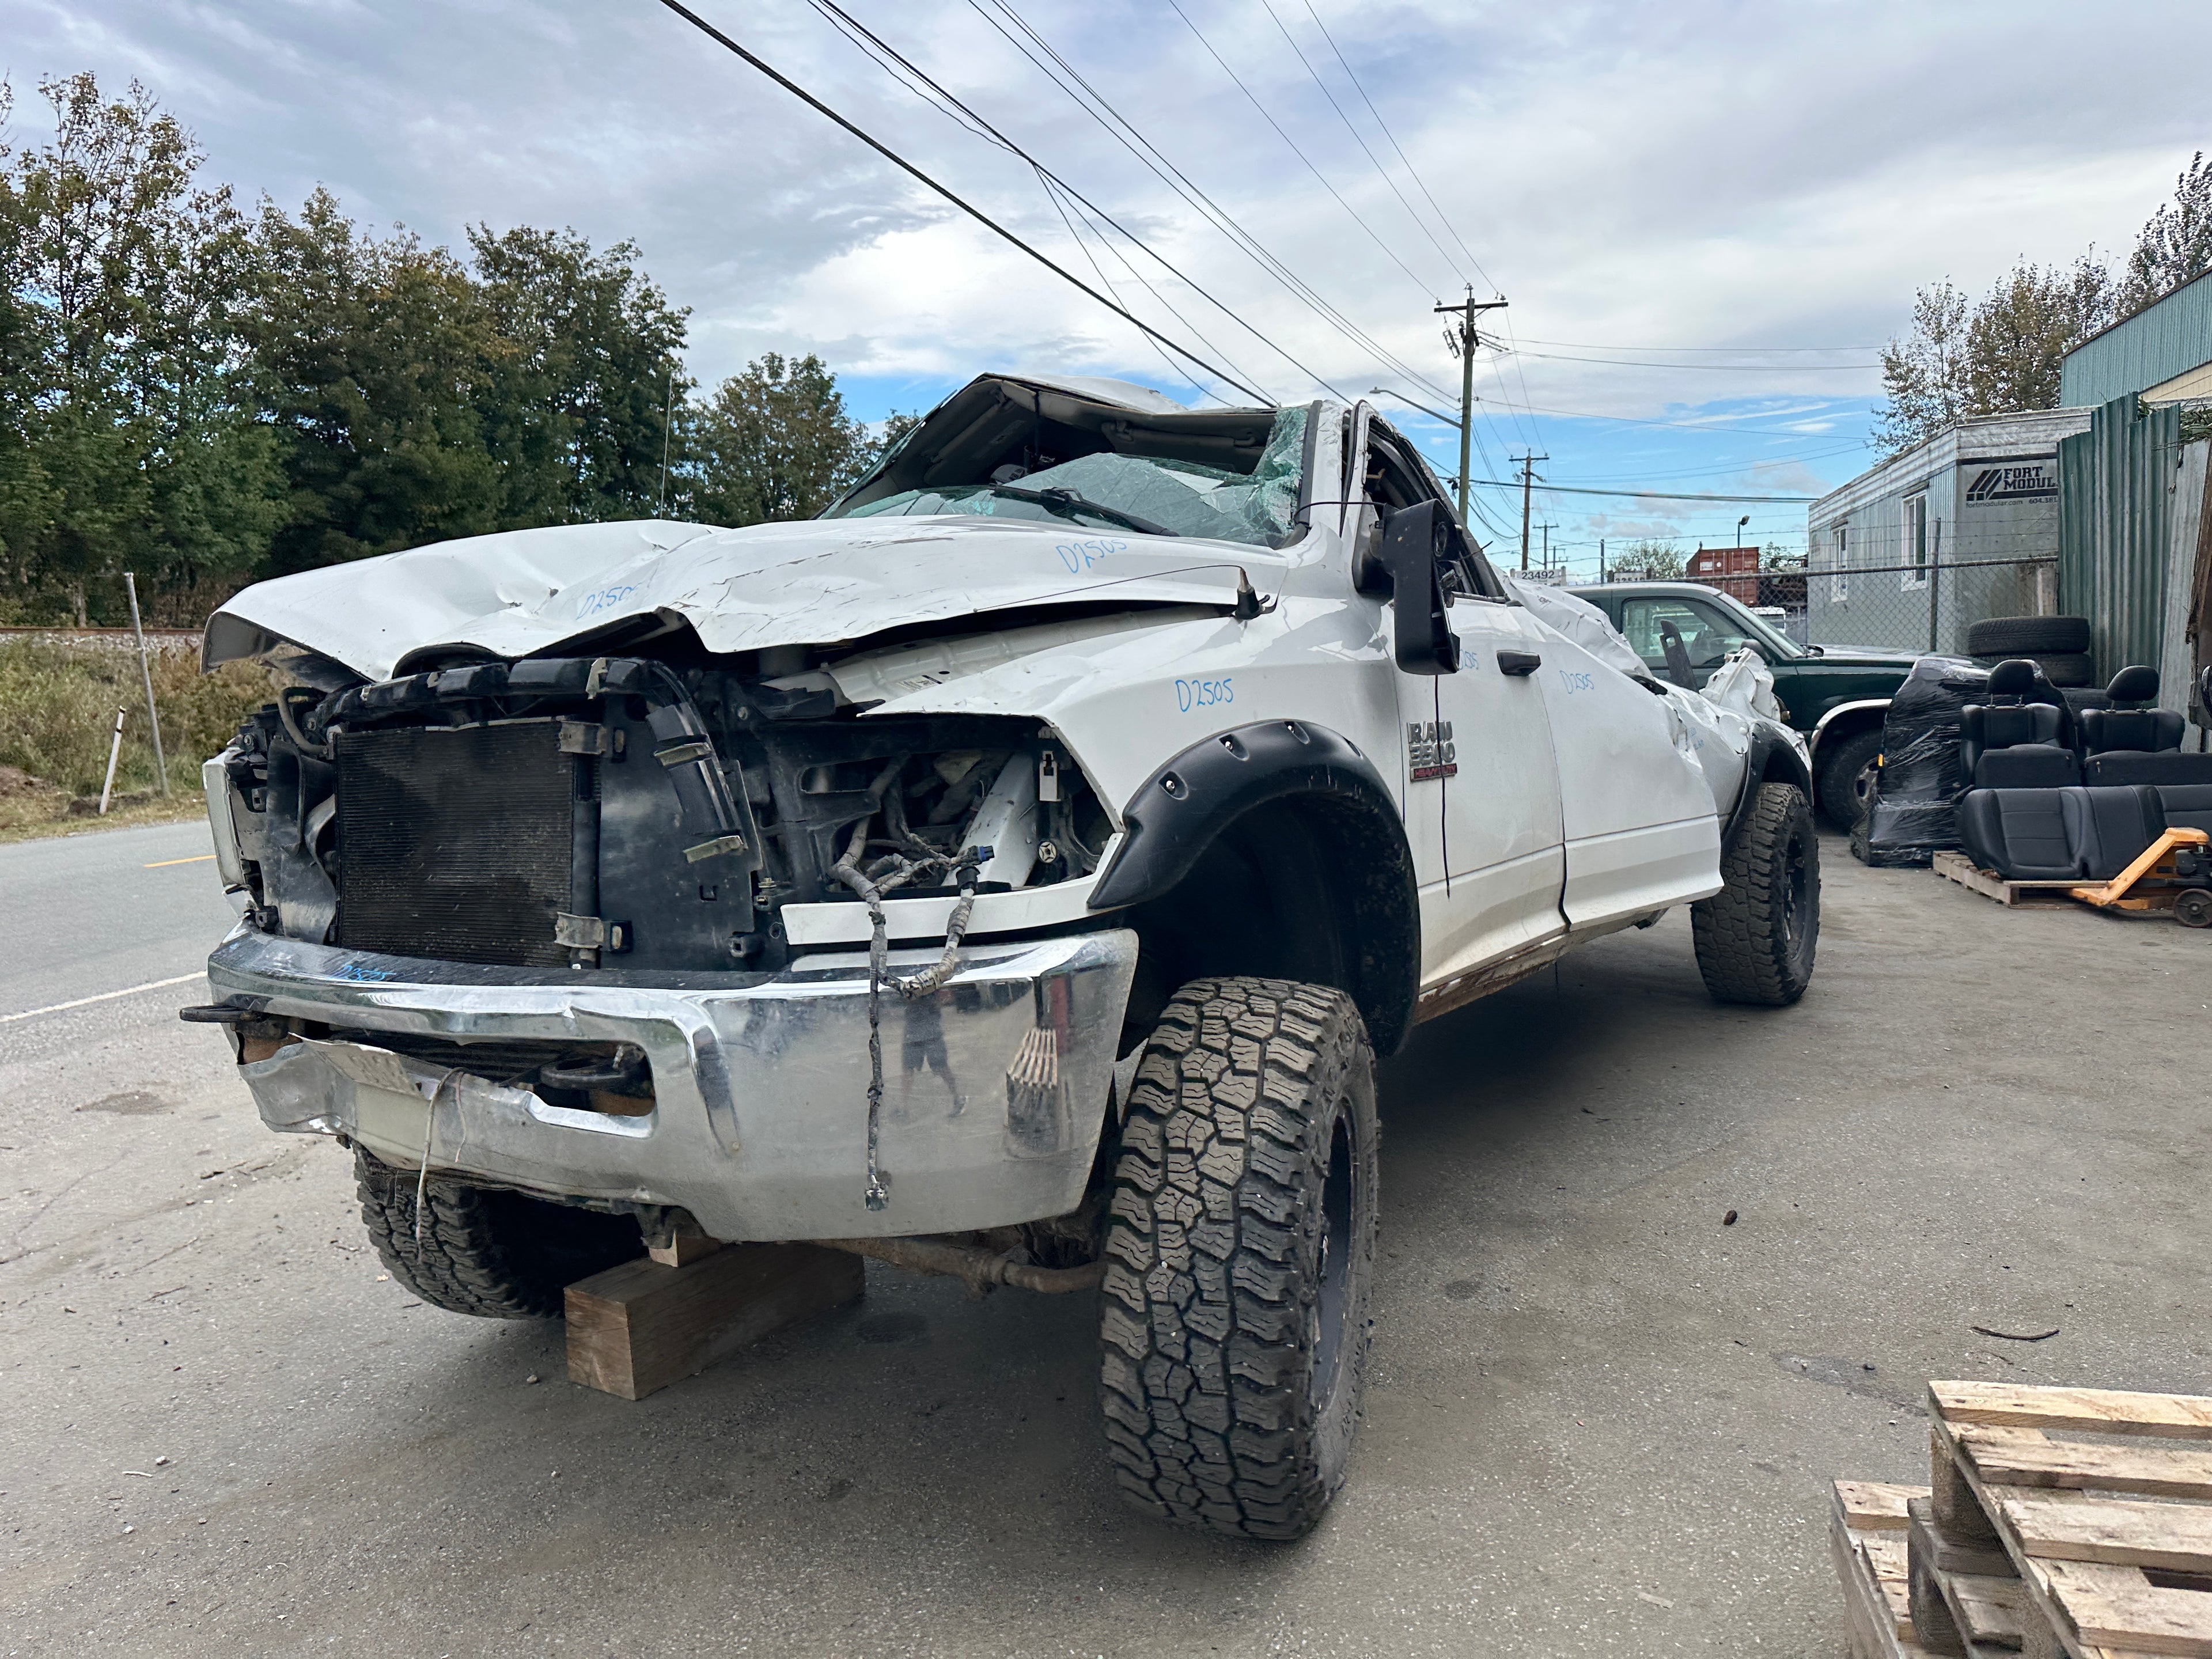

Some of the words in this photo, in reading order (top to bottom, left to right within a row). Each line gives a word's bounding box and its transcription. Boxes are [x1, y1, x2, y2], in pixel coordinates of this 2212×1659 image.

[2003, 466, 2043, 479] FORT
[2003, 477, 2058, 490] MODUL
[1966, 500, 2023, 508] fortmodular.com
[1056, 539, 1127, 573] D2505
[1521, 570, 1554, 579] 23492
[1559, 670, 1594, 694] D2505
[1175, 678, 1233, 712] D2505
[1407, 721, 1453, 743] RAM
